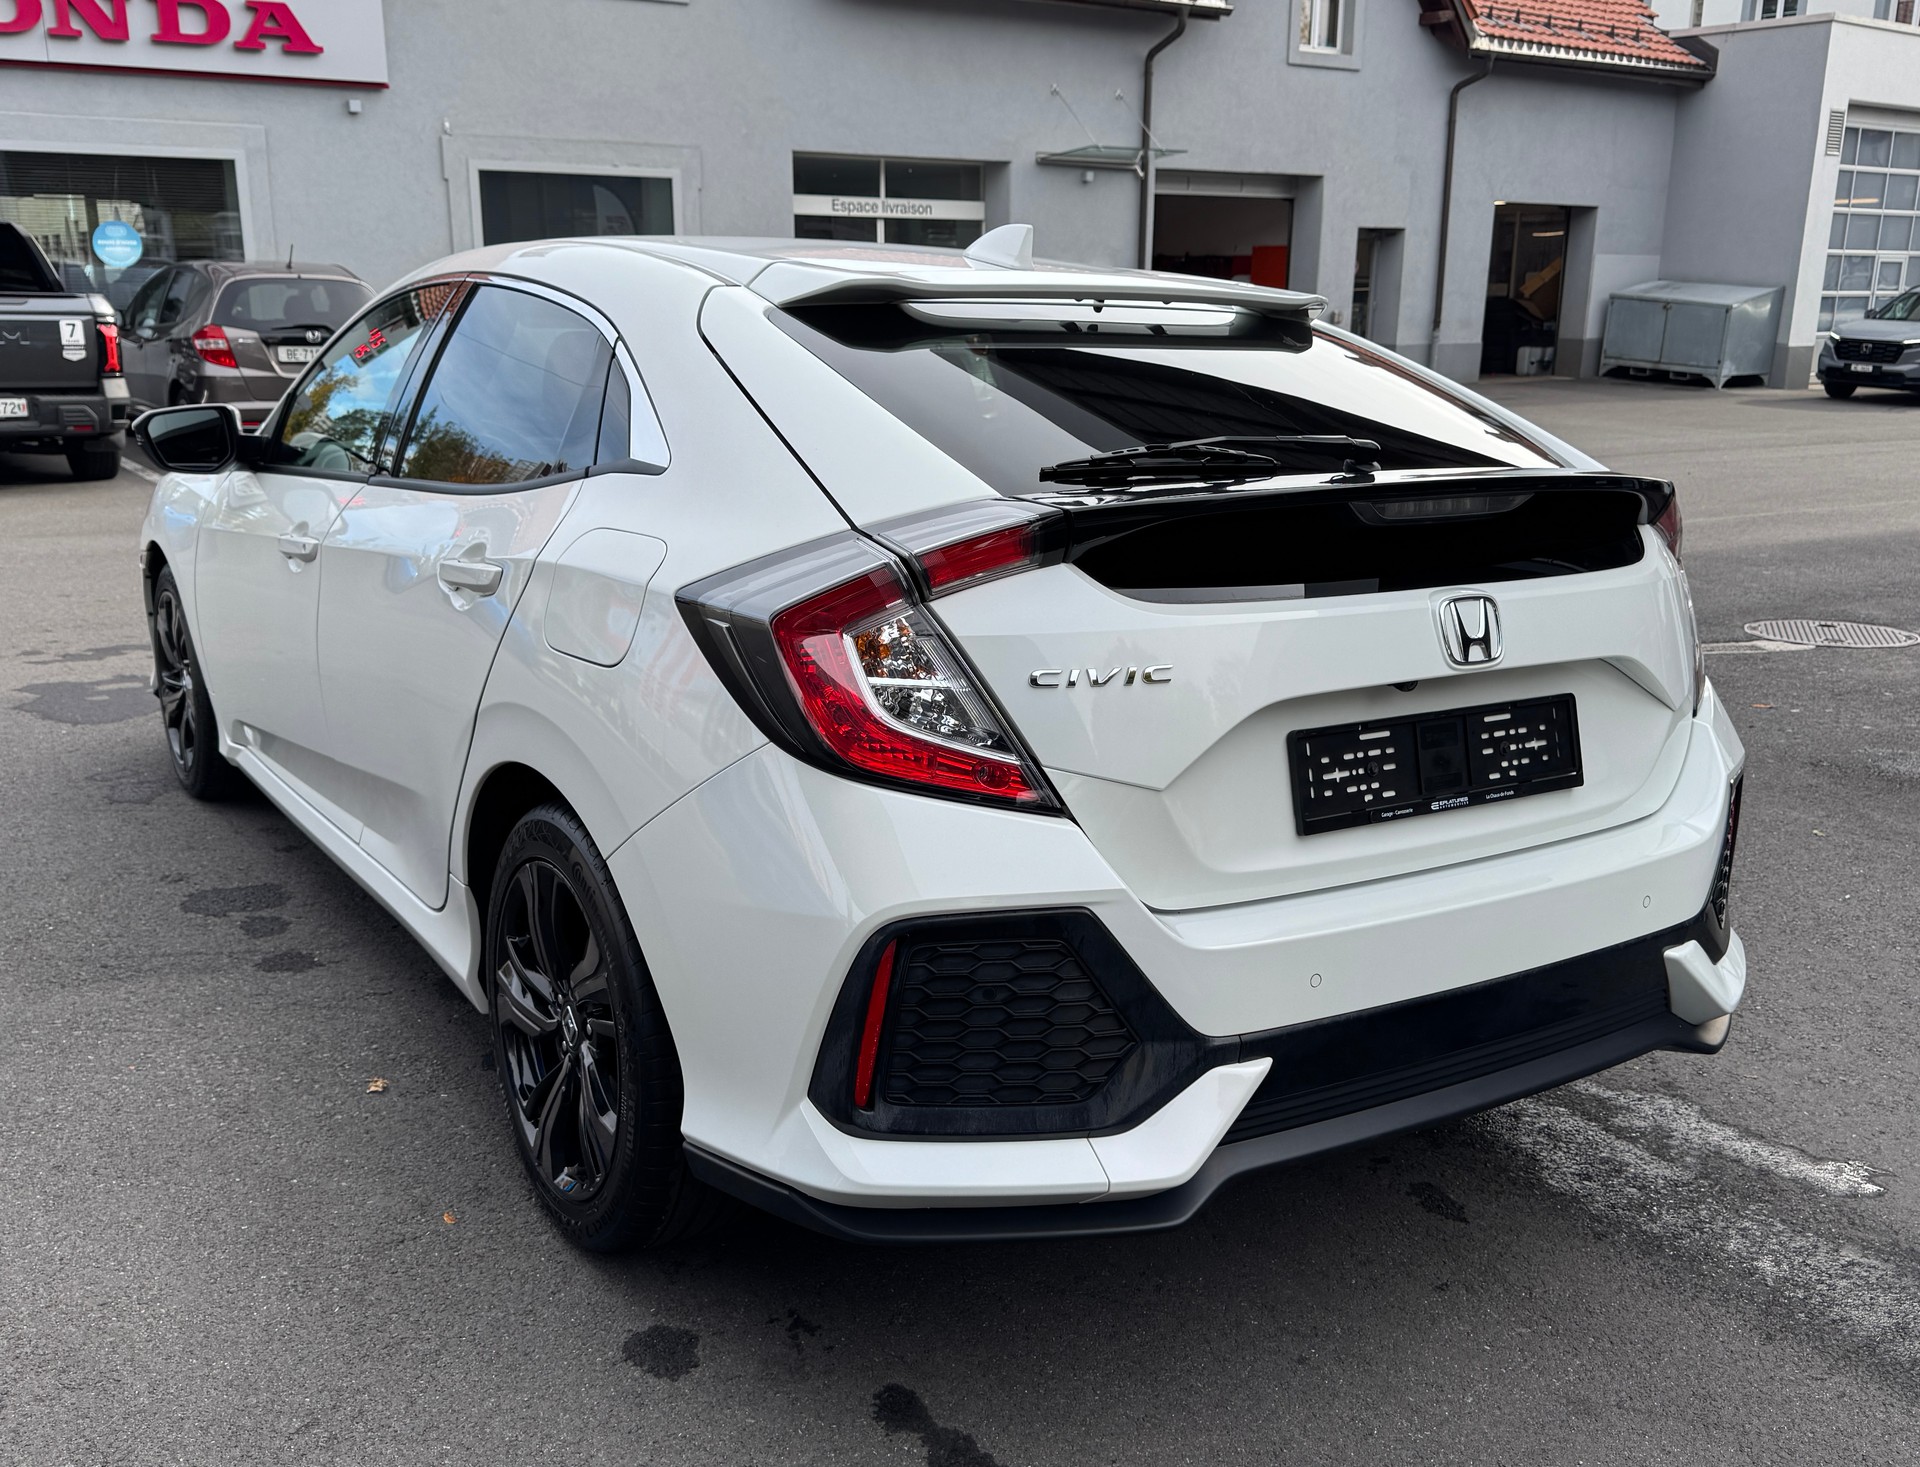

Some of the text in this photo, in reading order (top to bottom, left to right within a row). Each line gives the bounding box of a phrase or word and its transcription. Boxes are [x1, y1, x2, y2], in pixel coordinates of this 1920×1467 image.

[832, 198, 933, 215] Espace livraison
[65, 323, 76, 338] 7
[1028, 664, 1174, 688] CIVIC
